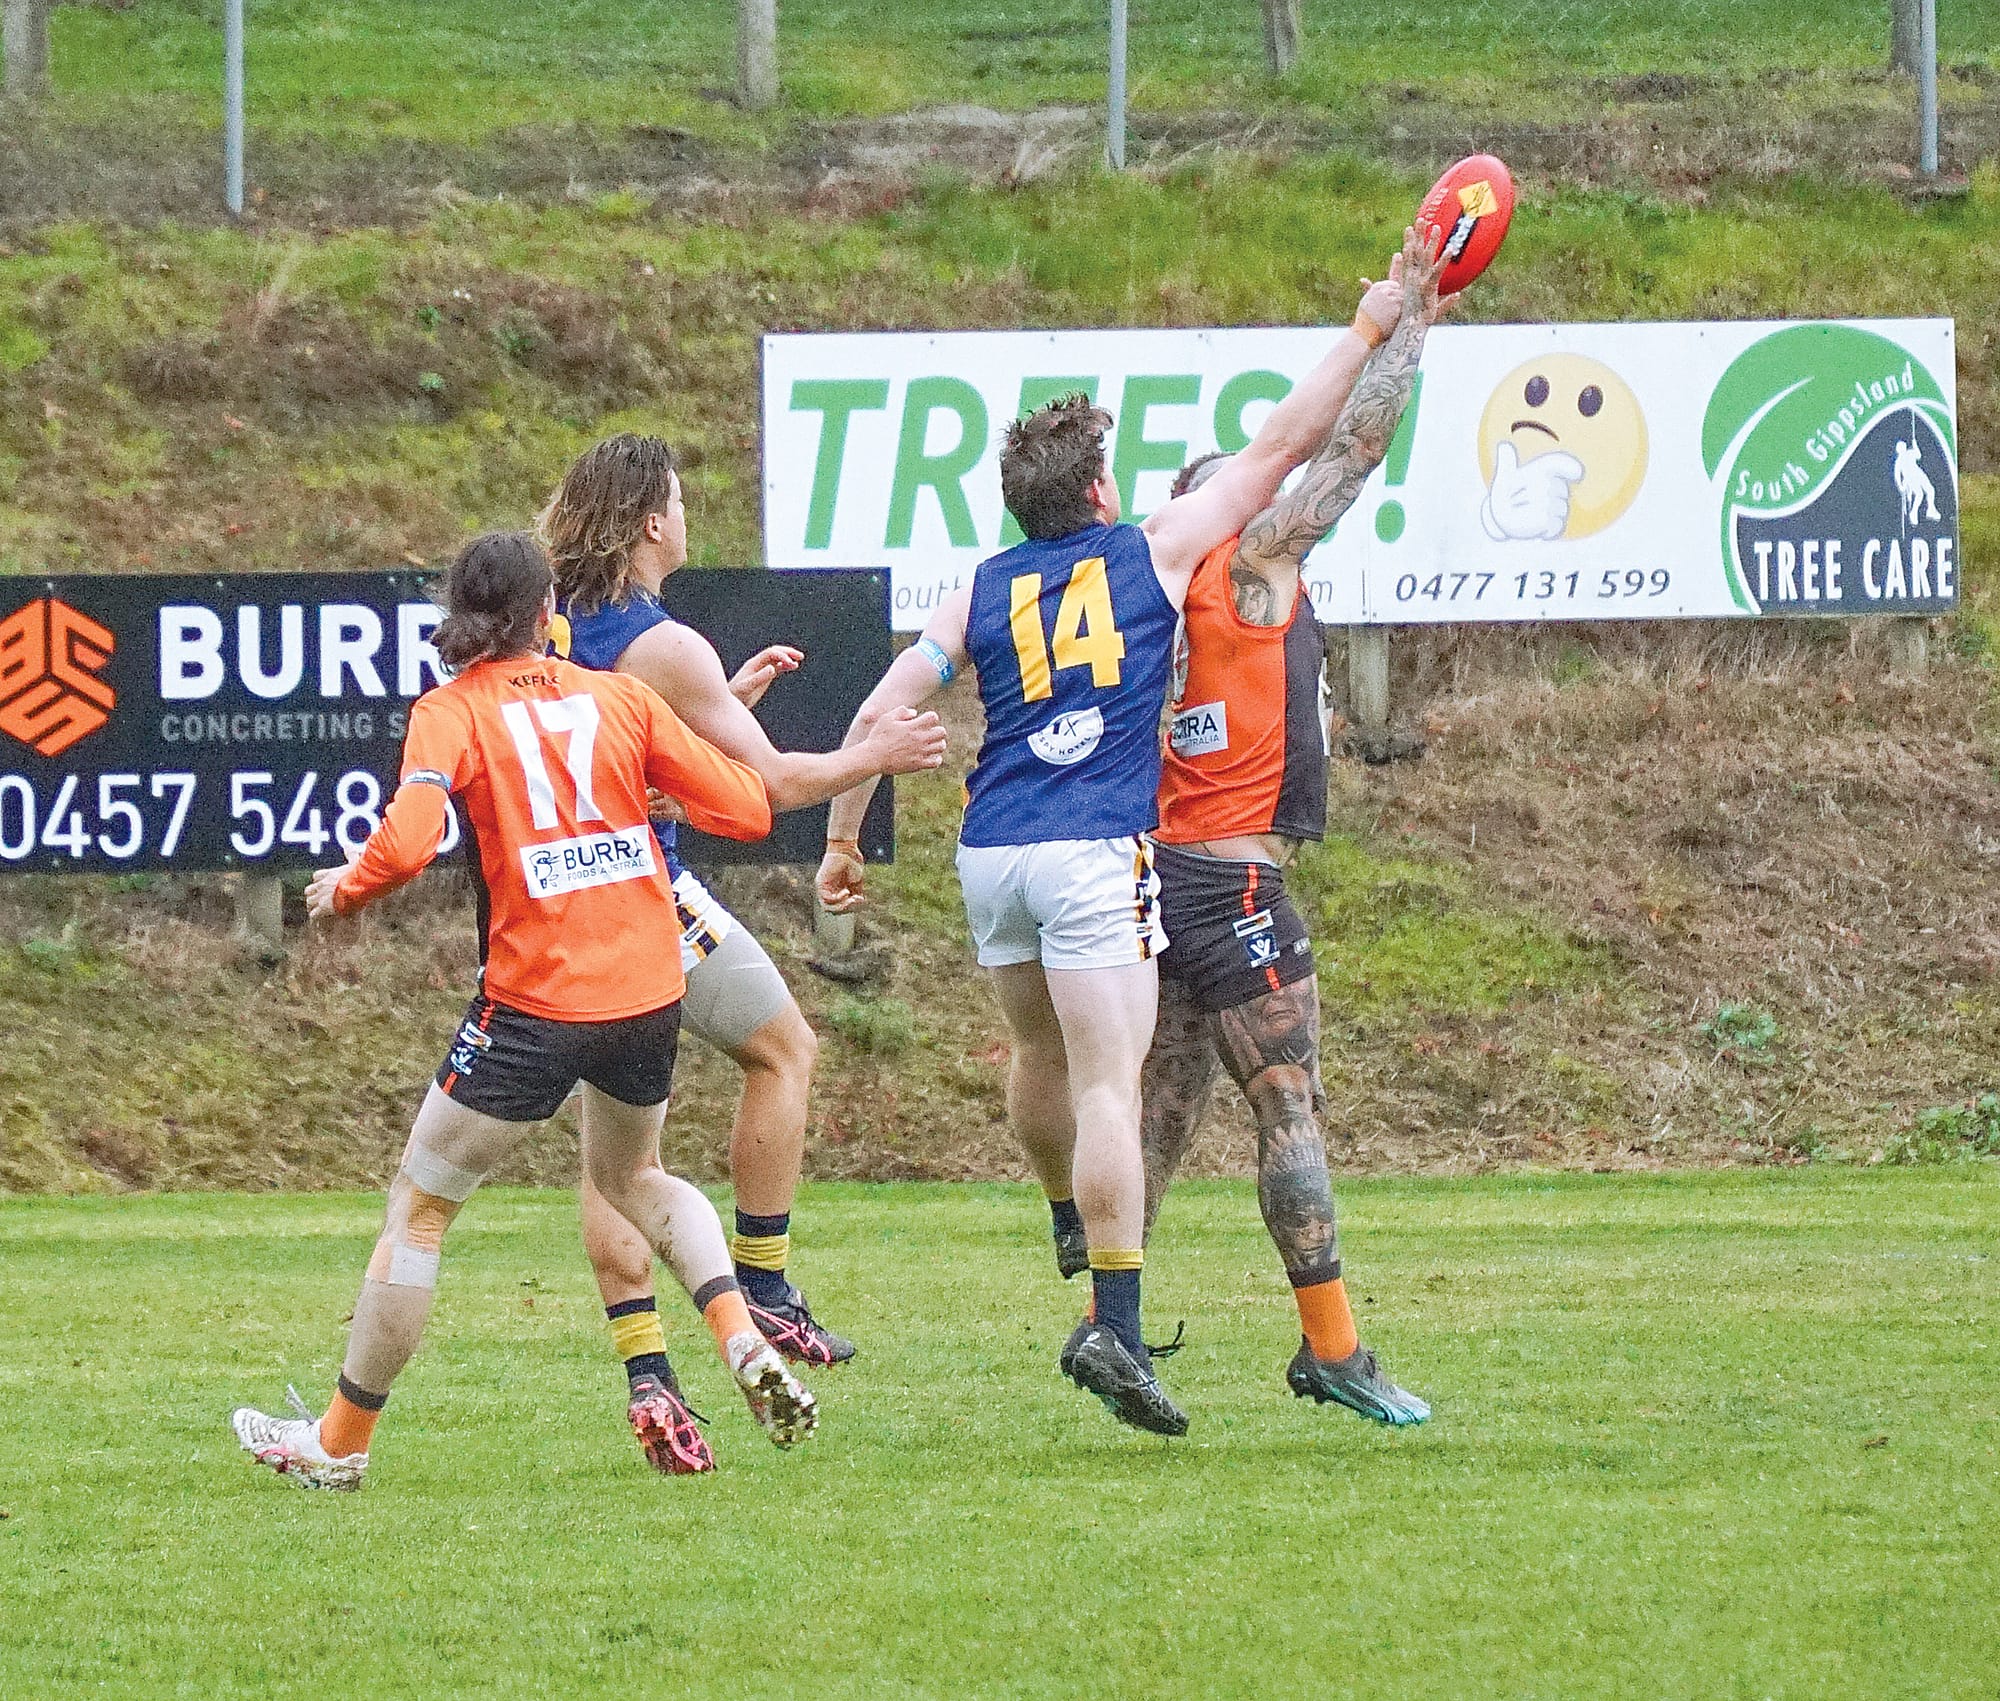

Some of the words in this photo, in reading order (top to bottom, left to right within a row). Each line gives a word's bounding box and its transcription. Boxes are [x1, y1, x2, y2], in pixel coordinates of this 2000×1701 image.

[1735, 462, 1810, 502] South
[1806, 360, 1915, 463] Gippsland
[1394, 572, 1496, 602] 0477
[1513, 569, 1581, 600] 131
[1597, 567, 1671, 599] 599
[1753, 539, 1843, 601] TREE
[1863, 536, 1954, 600] CARE
[1009, 555, 1126, 704] 14
[161, 712, 375, 742] CONCRETING
[500, 693, 603, 831] 17
[0, 771, 197, 860] 0457
[229, 770, 382, 856] 548
[563, 837, 644, 871] BURRA
